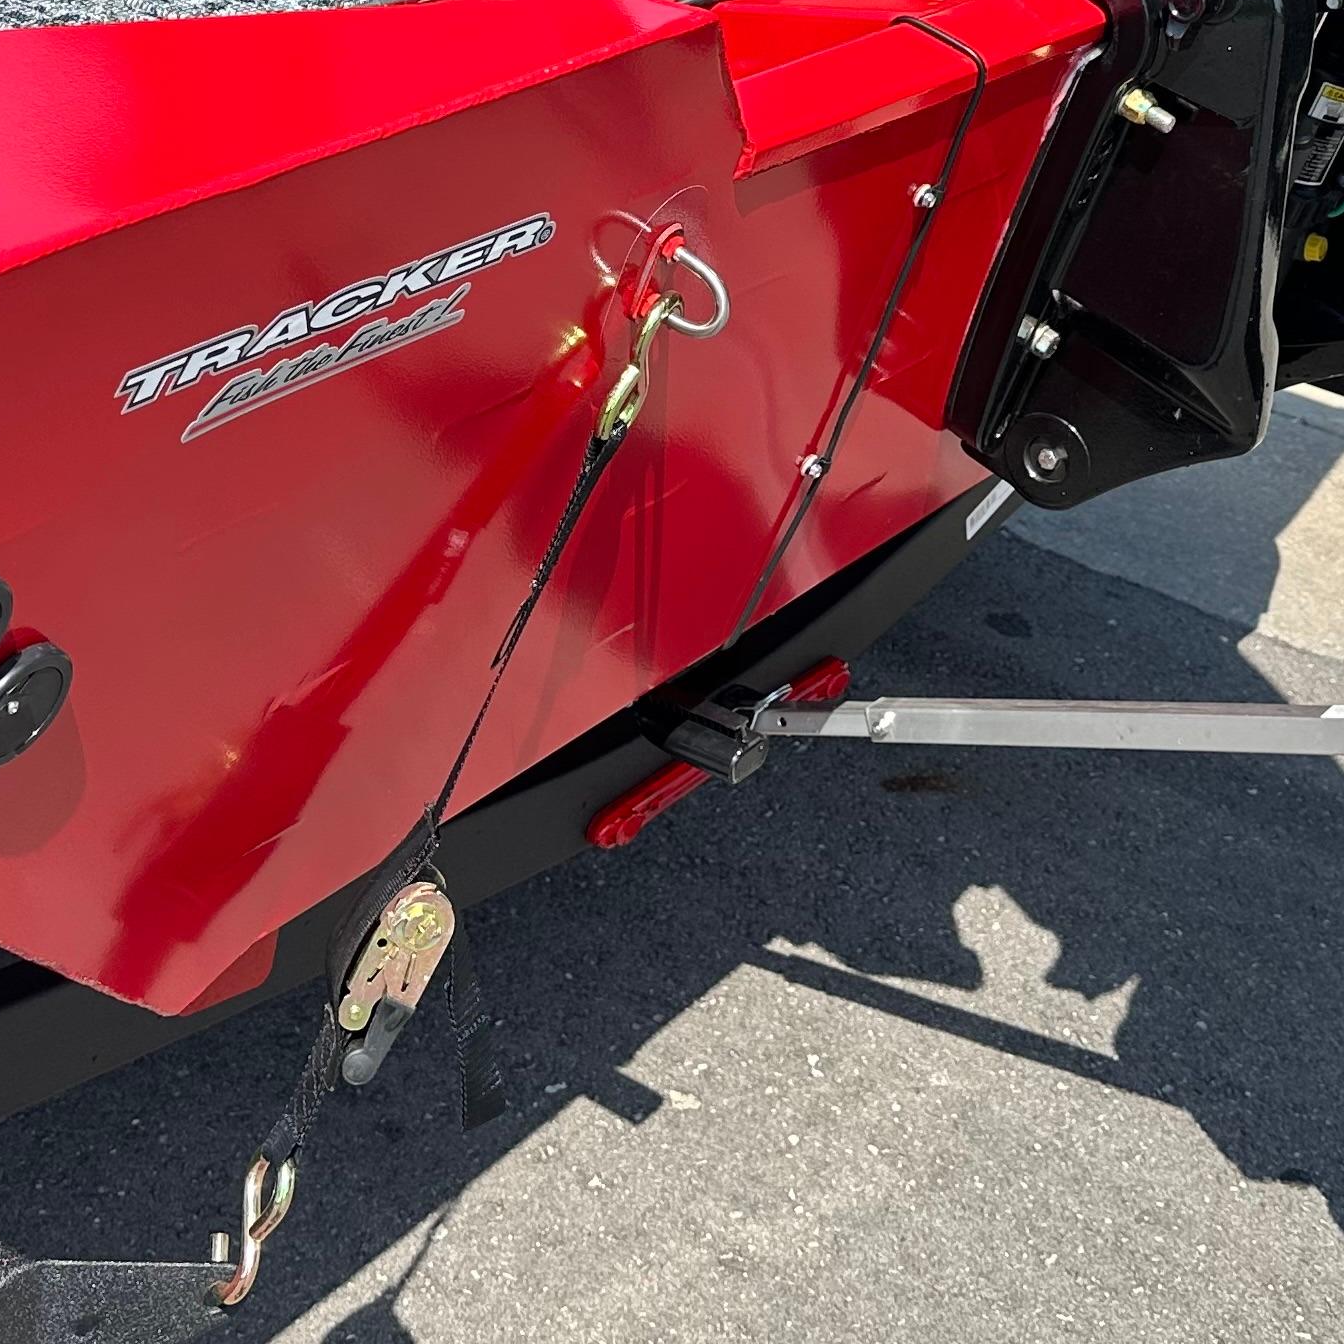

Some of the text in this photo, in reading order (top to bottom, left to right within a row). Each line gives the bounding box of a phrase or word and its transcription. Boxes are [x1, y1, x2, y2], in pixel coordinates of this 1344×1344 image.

[124, 216, 548, 412] TRACKER
[204, 365, 280, 418] Fish
[285, 344, 333, 384] the
